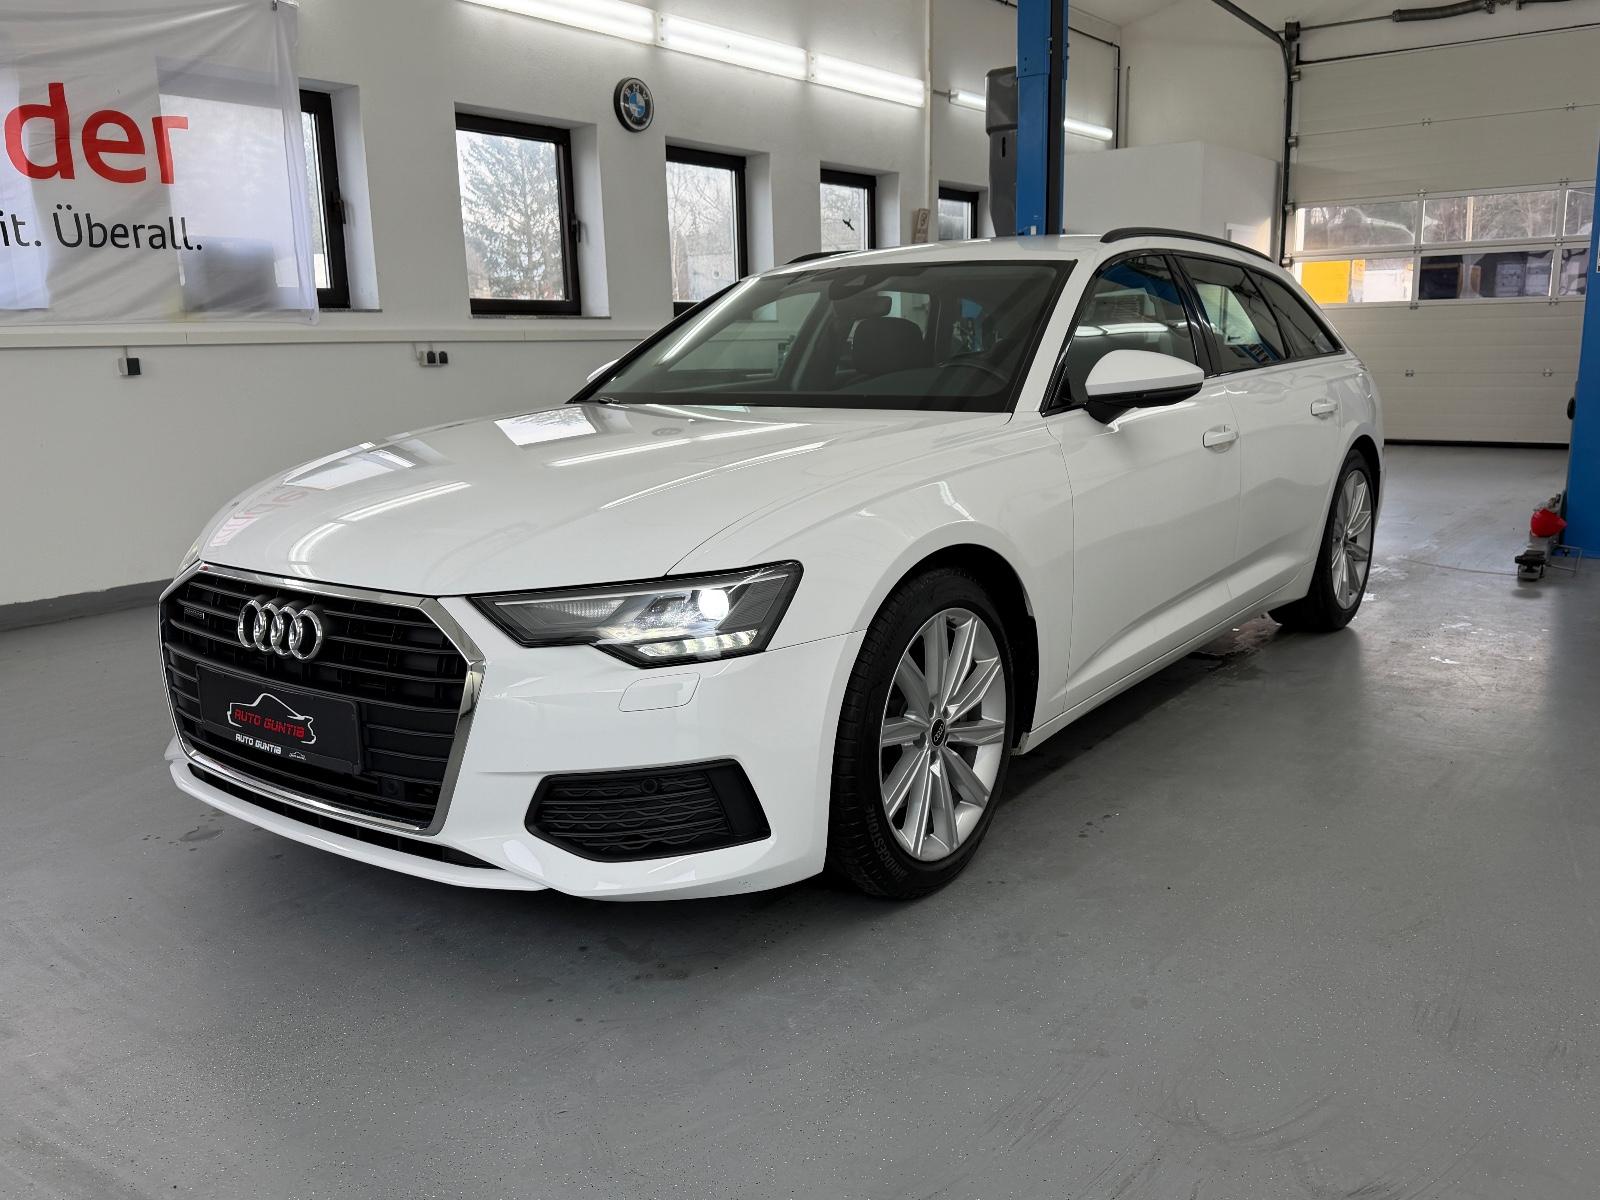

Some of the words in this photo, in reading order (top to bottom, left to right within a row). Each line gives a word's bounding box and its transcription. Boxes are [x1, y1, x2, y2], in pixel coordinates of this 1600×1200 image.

[4, 82, 189, 184] der
[52, 204, 203, 251] Überall.
[234, 708, 261, 726] AUTO
[235, 733, 254, 746] AUTO
